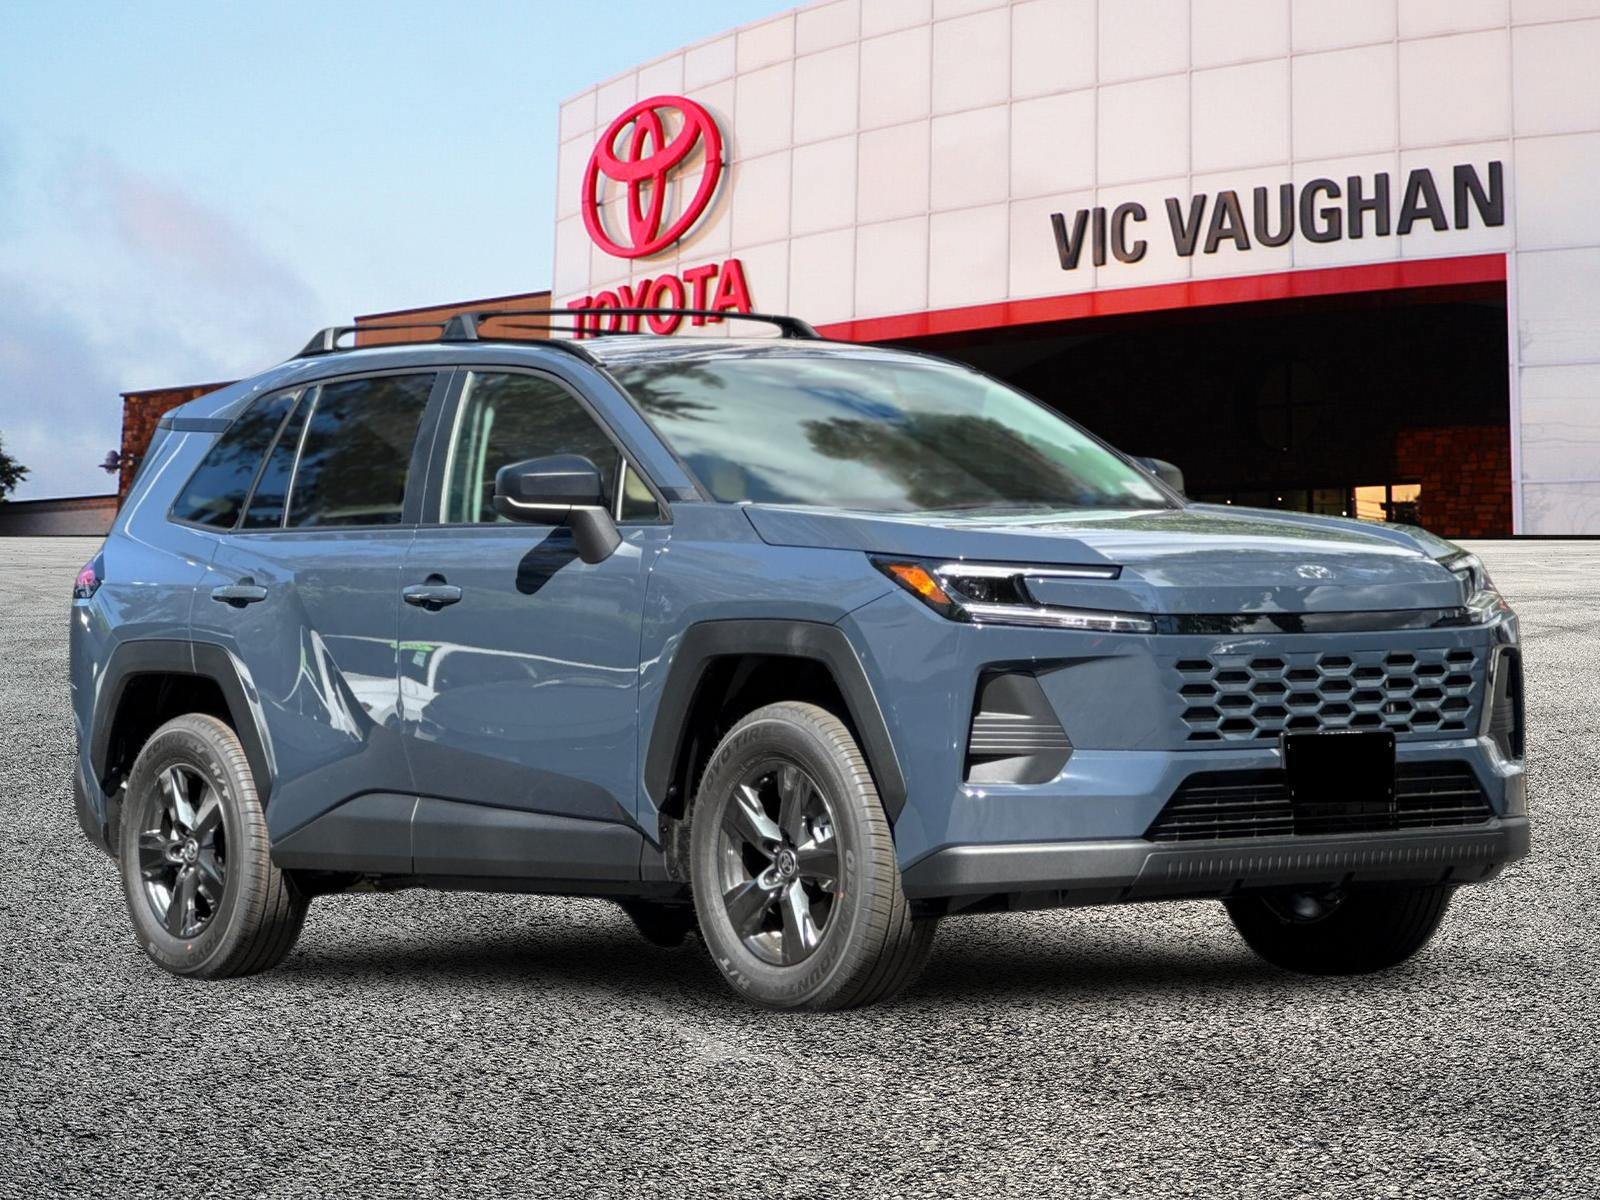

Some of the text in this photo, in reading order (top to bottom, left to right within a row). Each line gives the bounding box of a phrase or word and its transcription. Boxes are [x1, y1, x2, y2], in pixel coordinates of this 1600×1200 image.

[1050, 160, 1506, 270] VIC VAUGHAN
[566, 258, 753, 340] TOYOTA
